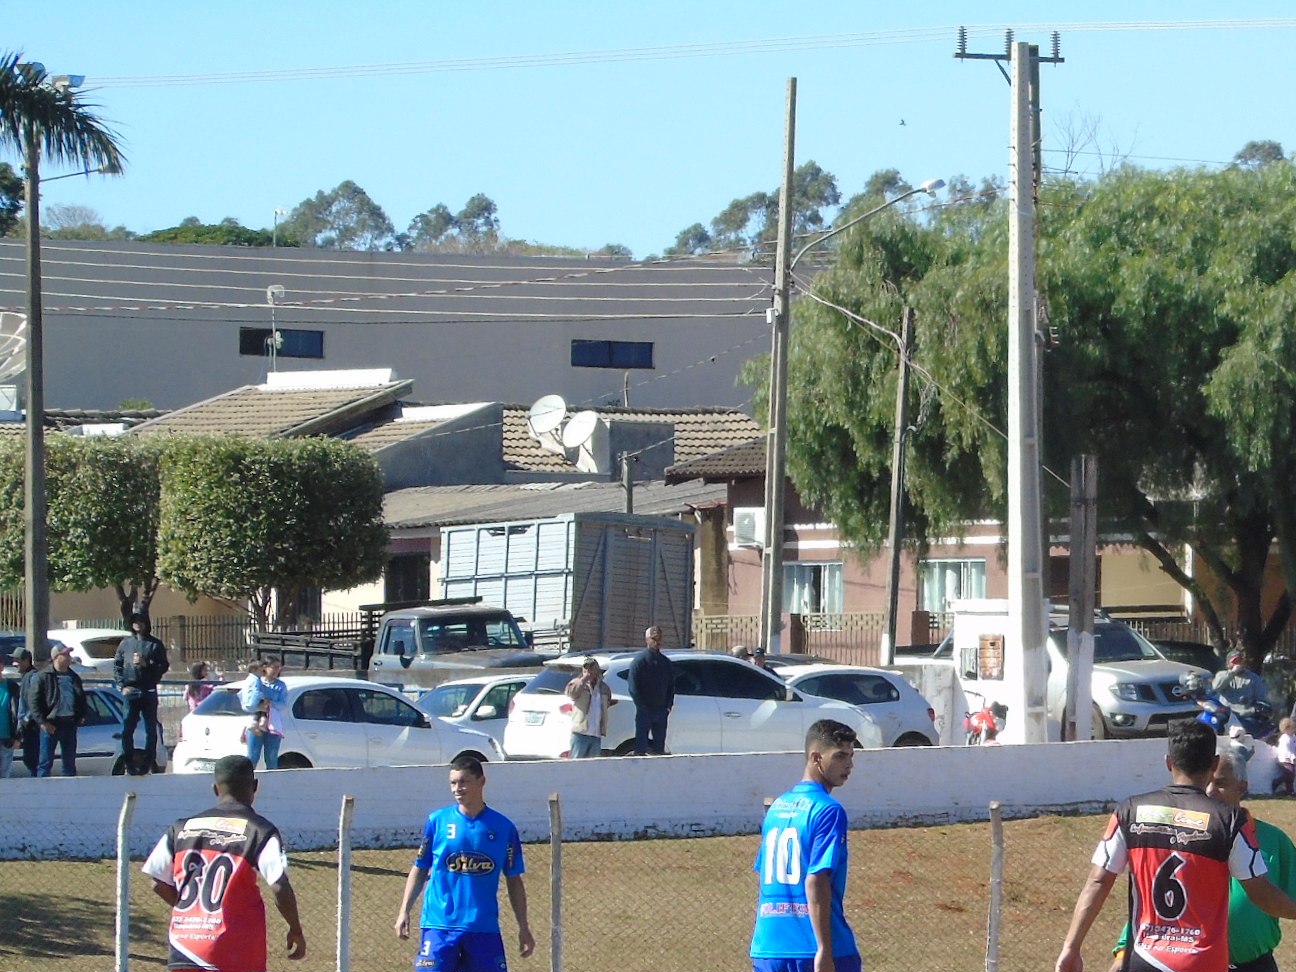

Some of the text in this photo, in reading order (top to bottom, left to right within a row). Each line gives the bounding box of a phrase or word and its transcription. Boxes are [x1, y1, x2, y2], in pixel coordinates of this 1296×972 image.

[446, 823, 456, 839] 3
[449, 854, 492, 872] Silva
[763, 827, 801, 885] 10
[1151, 851, 1187, 921] 6
[421, 941, 431, 956] 3
